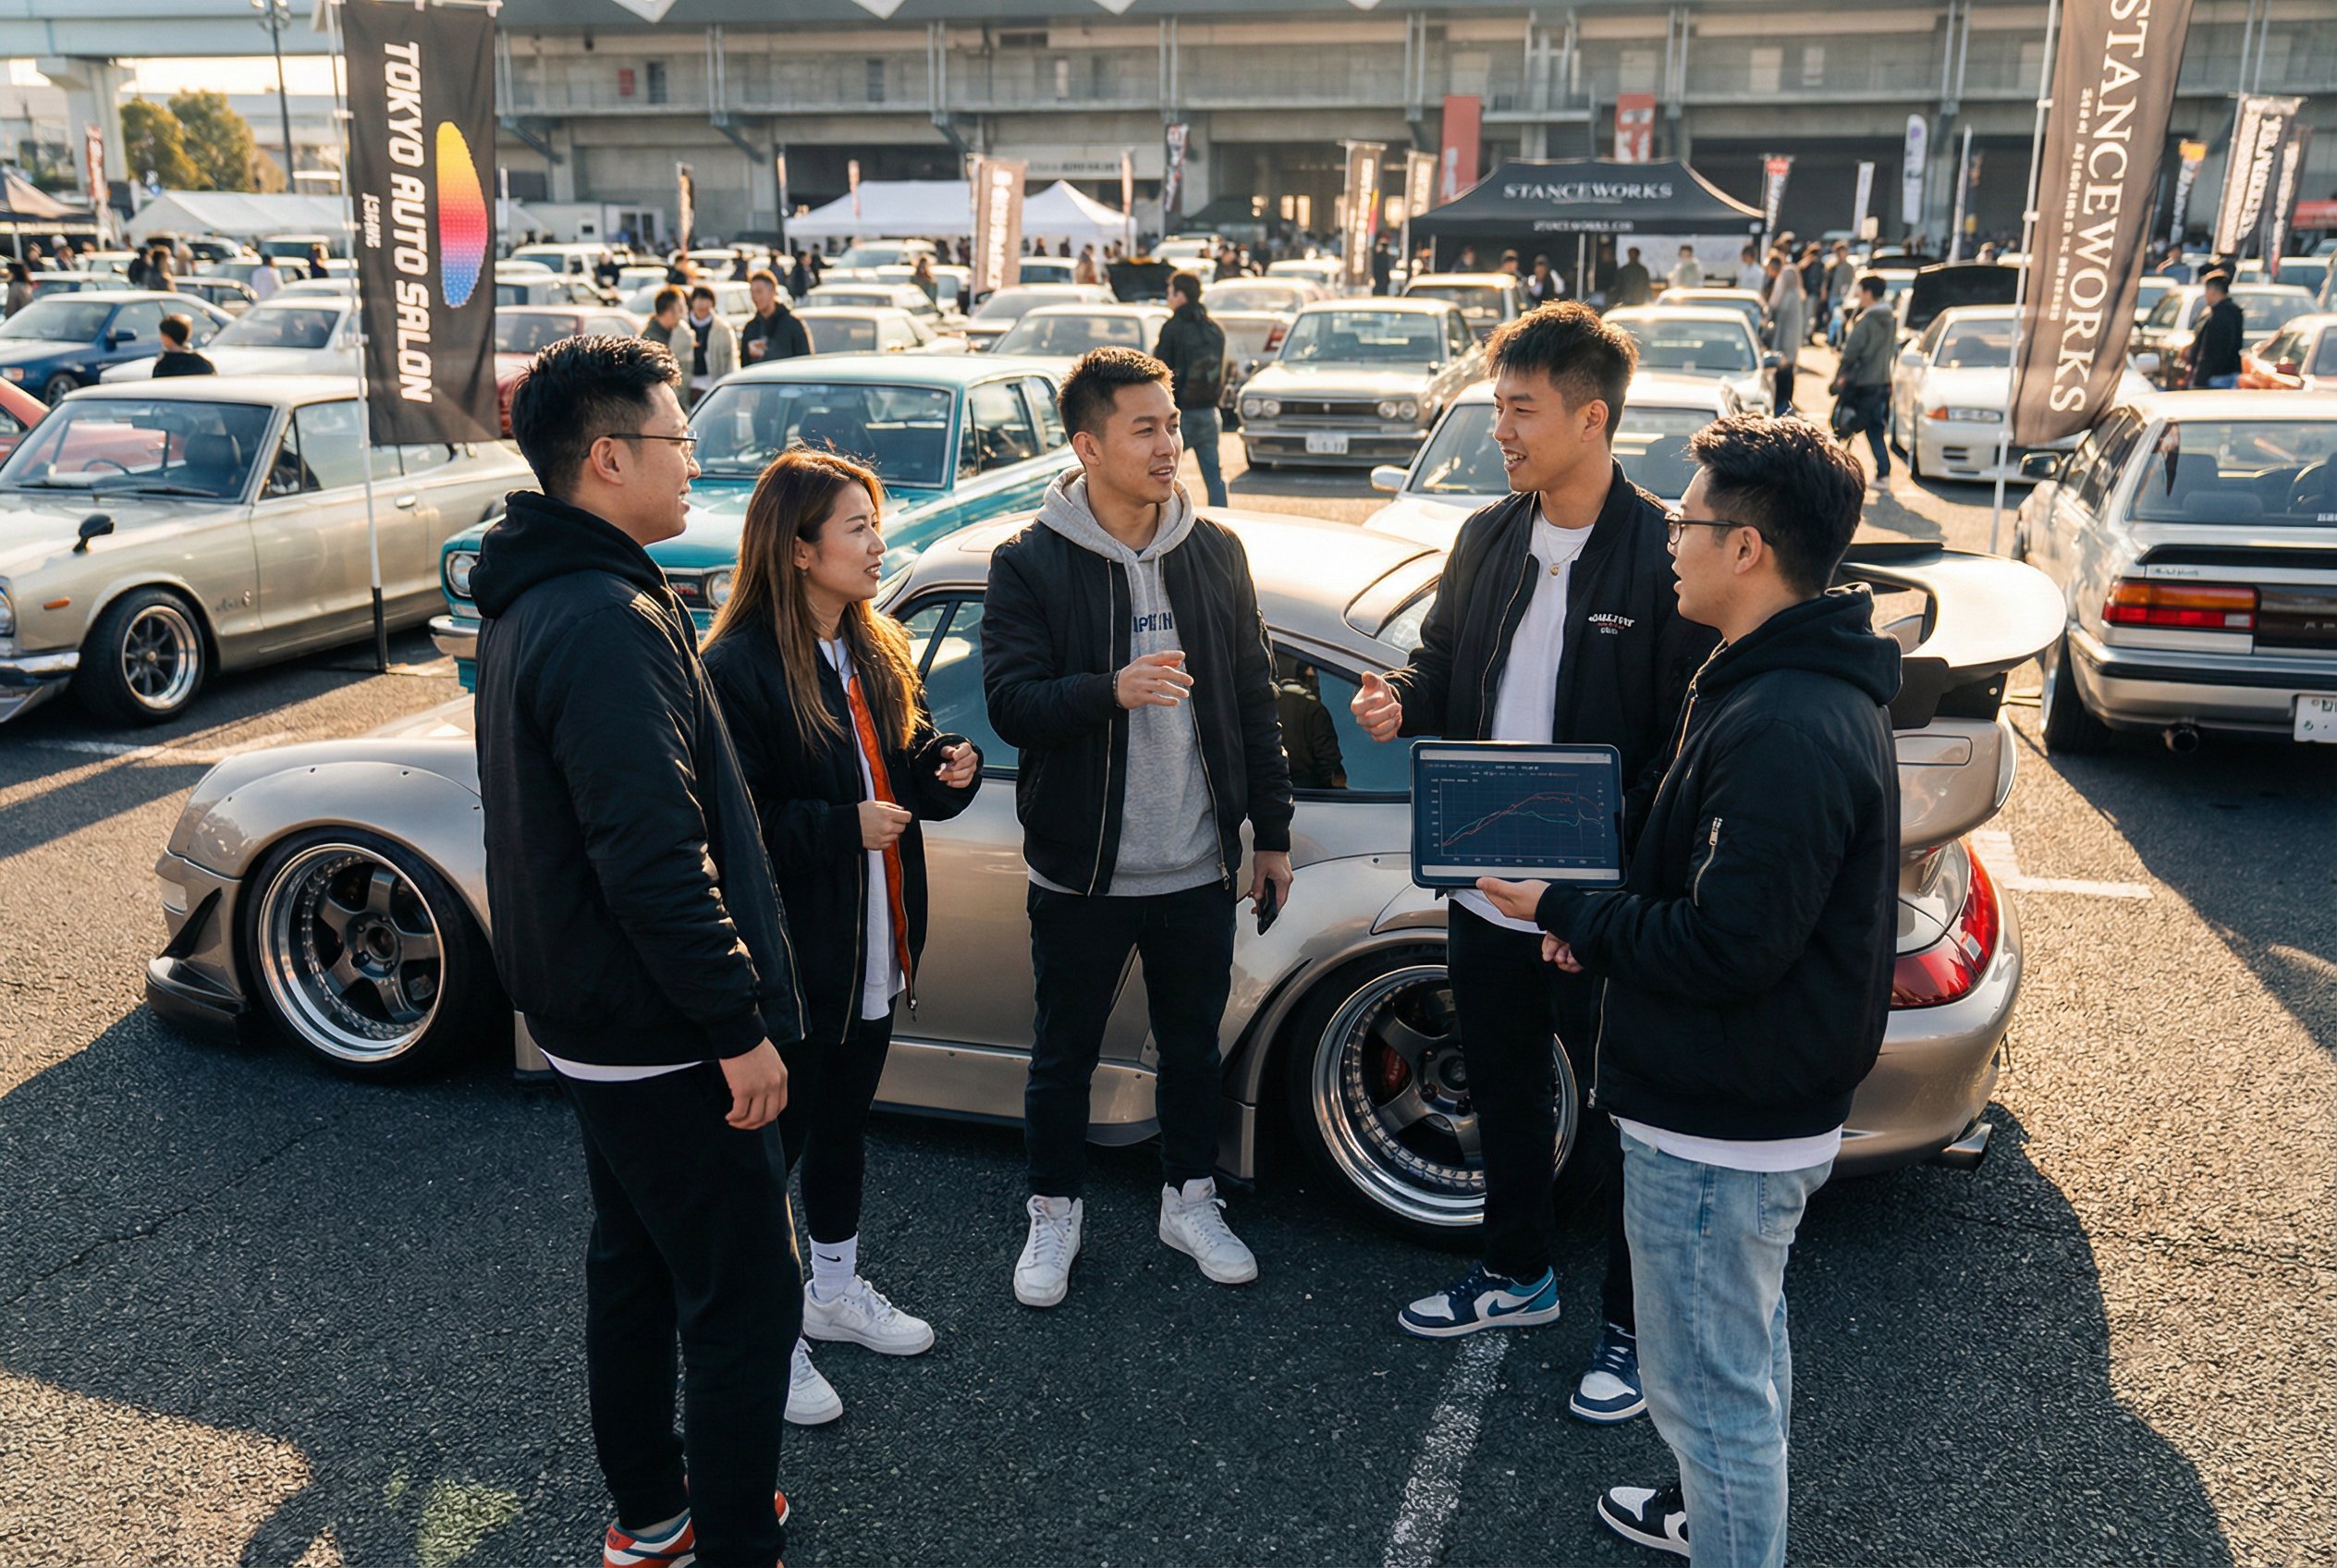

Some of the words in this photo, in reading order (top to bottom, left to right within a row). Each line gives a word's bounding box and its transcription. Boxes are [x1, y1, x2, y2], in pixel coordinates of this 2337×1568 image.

[384, 41, 424, 167] TOKYO
[391, 172, 429, 277] AUTO
[1503, 182, 1673, 200] STANCEWORKS
[2049, 0, 2152, 412] STANCEWORKS
[395, 278, 433, 404] SALON
